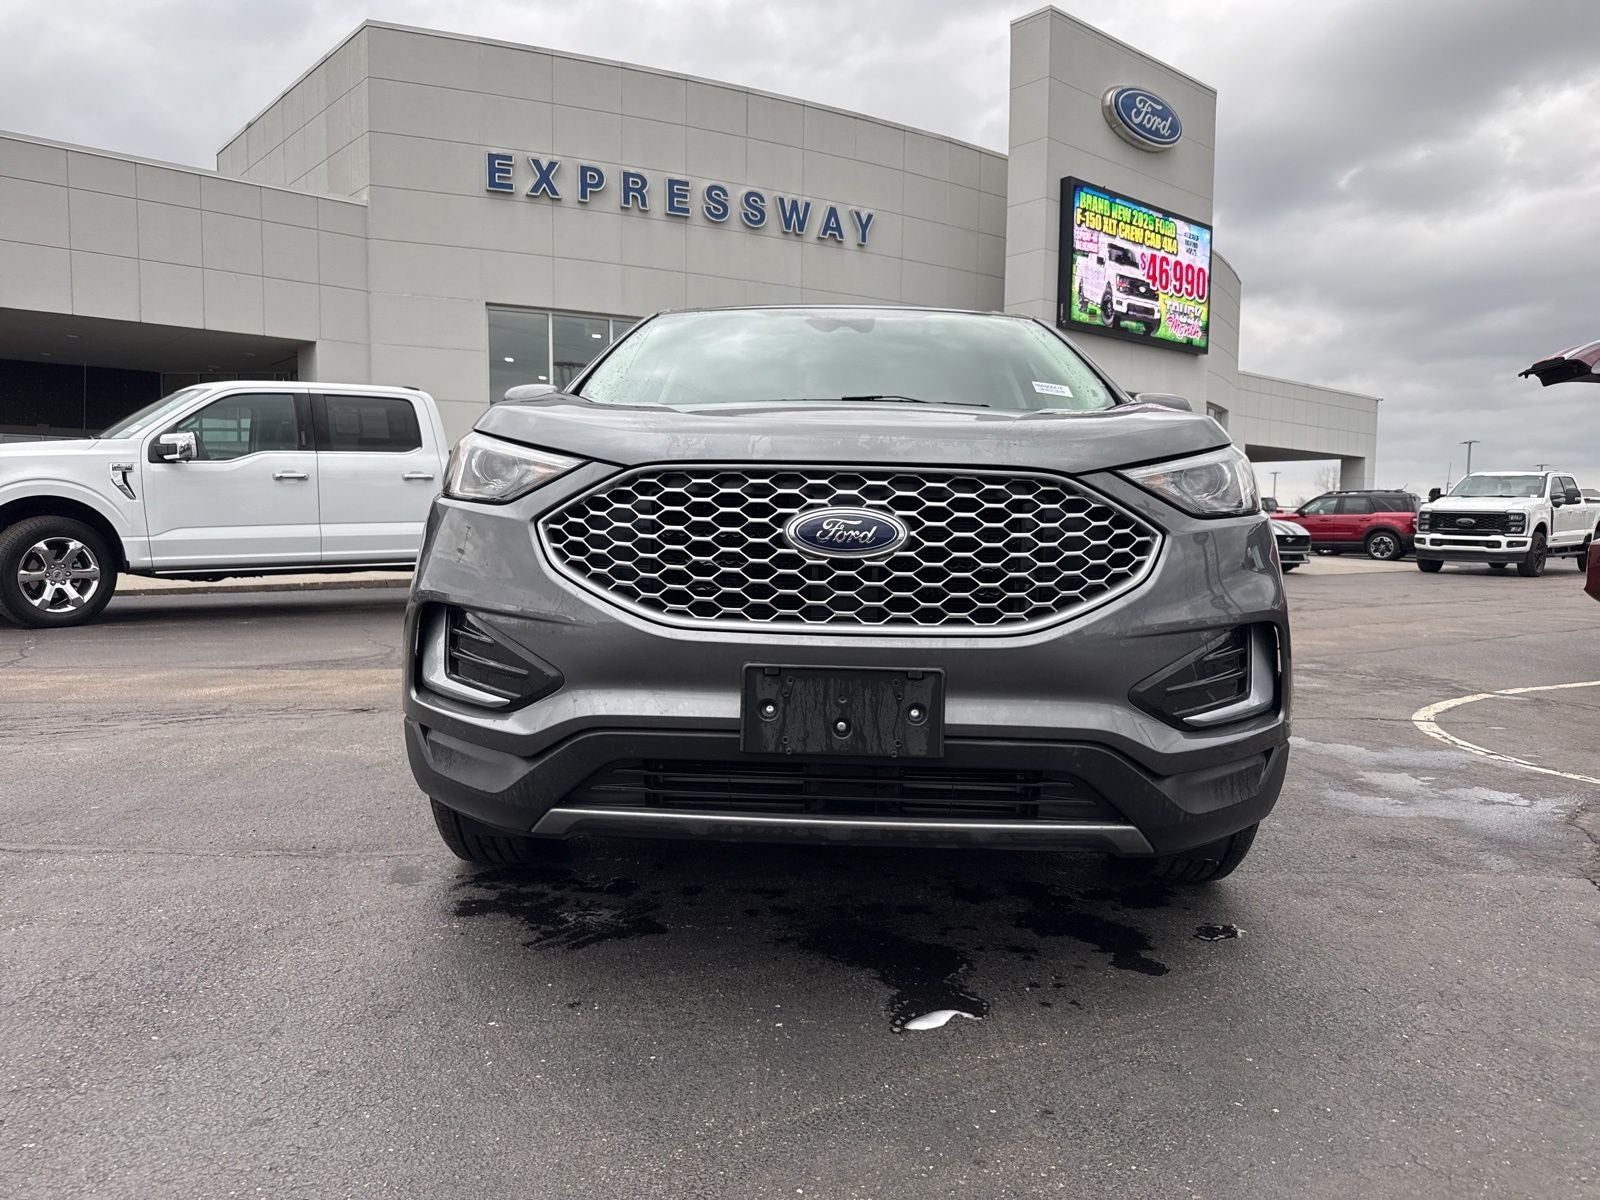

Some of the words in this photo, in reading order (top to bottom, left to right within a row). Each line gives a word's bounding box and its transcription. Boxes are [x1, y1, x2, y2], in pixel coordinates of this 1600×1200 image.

[1131, 95, 1172, 136] Ford
[485, 150, 876, 246] EXPRESSWAY
[1079, 191, 1111, 217] BRAND
[1111, 202, 1132, 224] NEW
[1155, 216, 1177, 238] FORD
[1076, 207, 1102, 231] F-150
[1103, 216, 1118, 236] XLT
[1119, 222, 1144, 245] CREW
[1144, 229, 1162, 250] CAB
[815, 518, 877, 544] Ford
